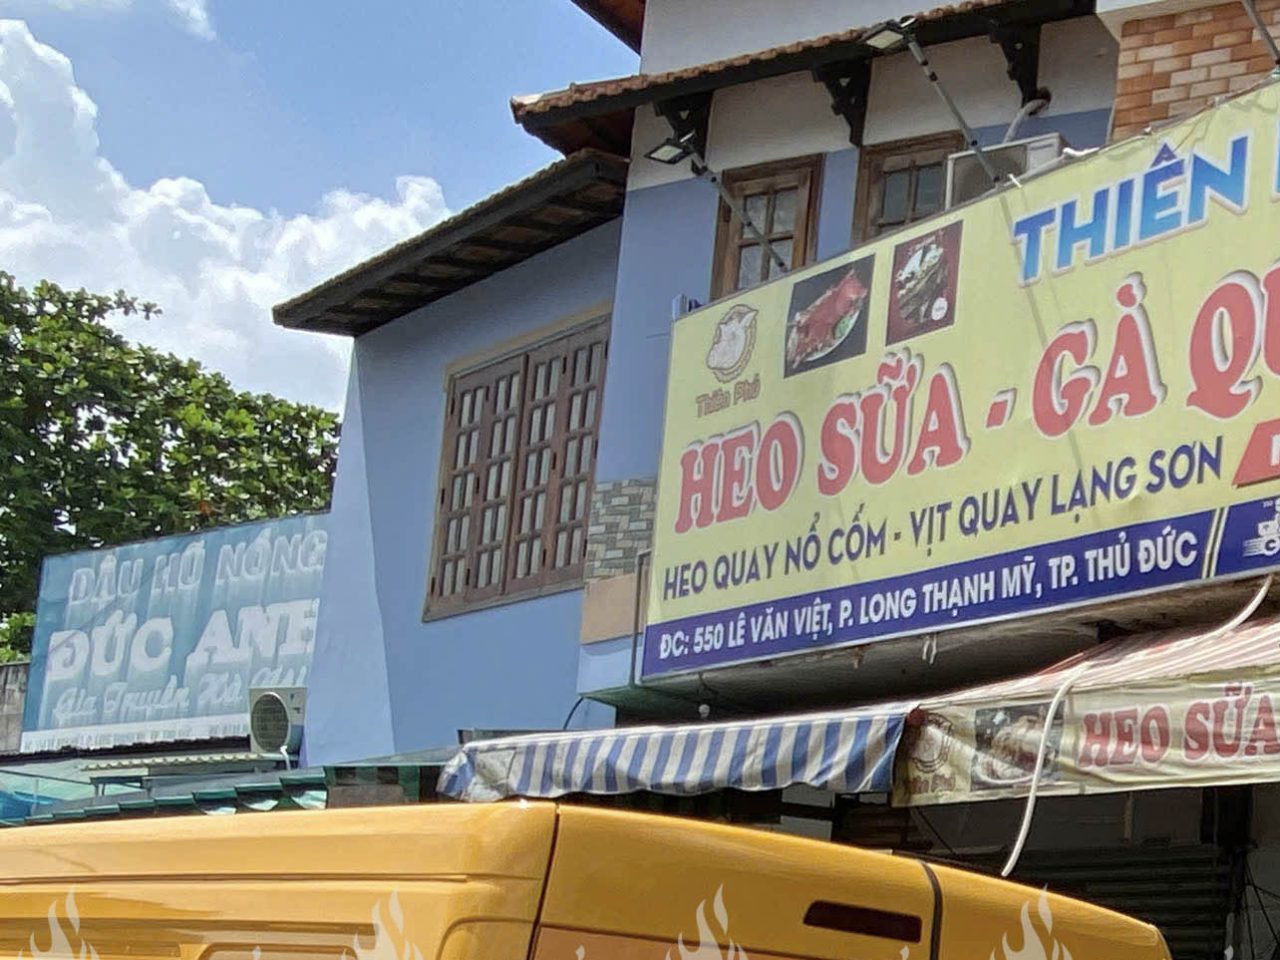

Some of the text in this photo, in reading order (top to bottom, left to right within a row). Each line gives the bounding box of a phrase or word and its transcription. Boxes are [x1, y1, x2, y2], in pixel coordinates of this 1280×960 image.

[1012, 144, 1248, 285] THIÊN
[674, 412, 804, 533] HEO
[817, 350, 969, 497] SỮA
[1032, 272, 1167, 439] GÀ
[663, 560, 708, 600] HEO
[713, 546, 777, 590] QUAY
[784, 523, 821, 577] NỔ
[827, 503, 886, 566] CỐM
[910, 502, 950, 557] VỊT
[958, 478, 1043, 537] QUAY
[1050, 457, 1136, 523] LẠNG
[1146, 436, 1223, 493] SƠN
[47, 609, 174, 680] ĐỨC
[659, 526, 1198, 660] ĐC: 550 LÊ VĂN VIỆT, P. LONG THẠNH MỸ, TP. THỦ ĐỨC
[1077, 703, 1173, 768] HEO
